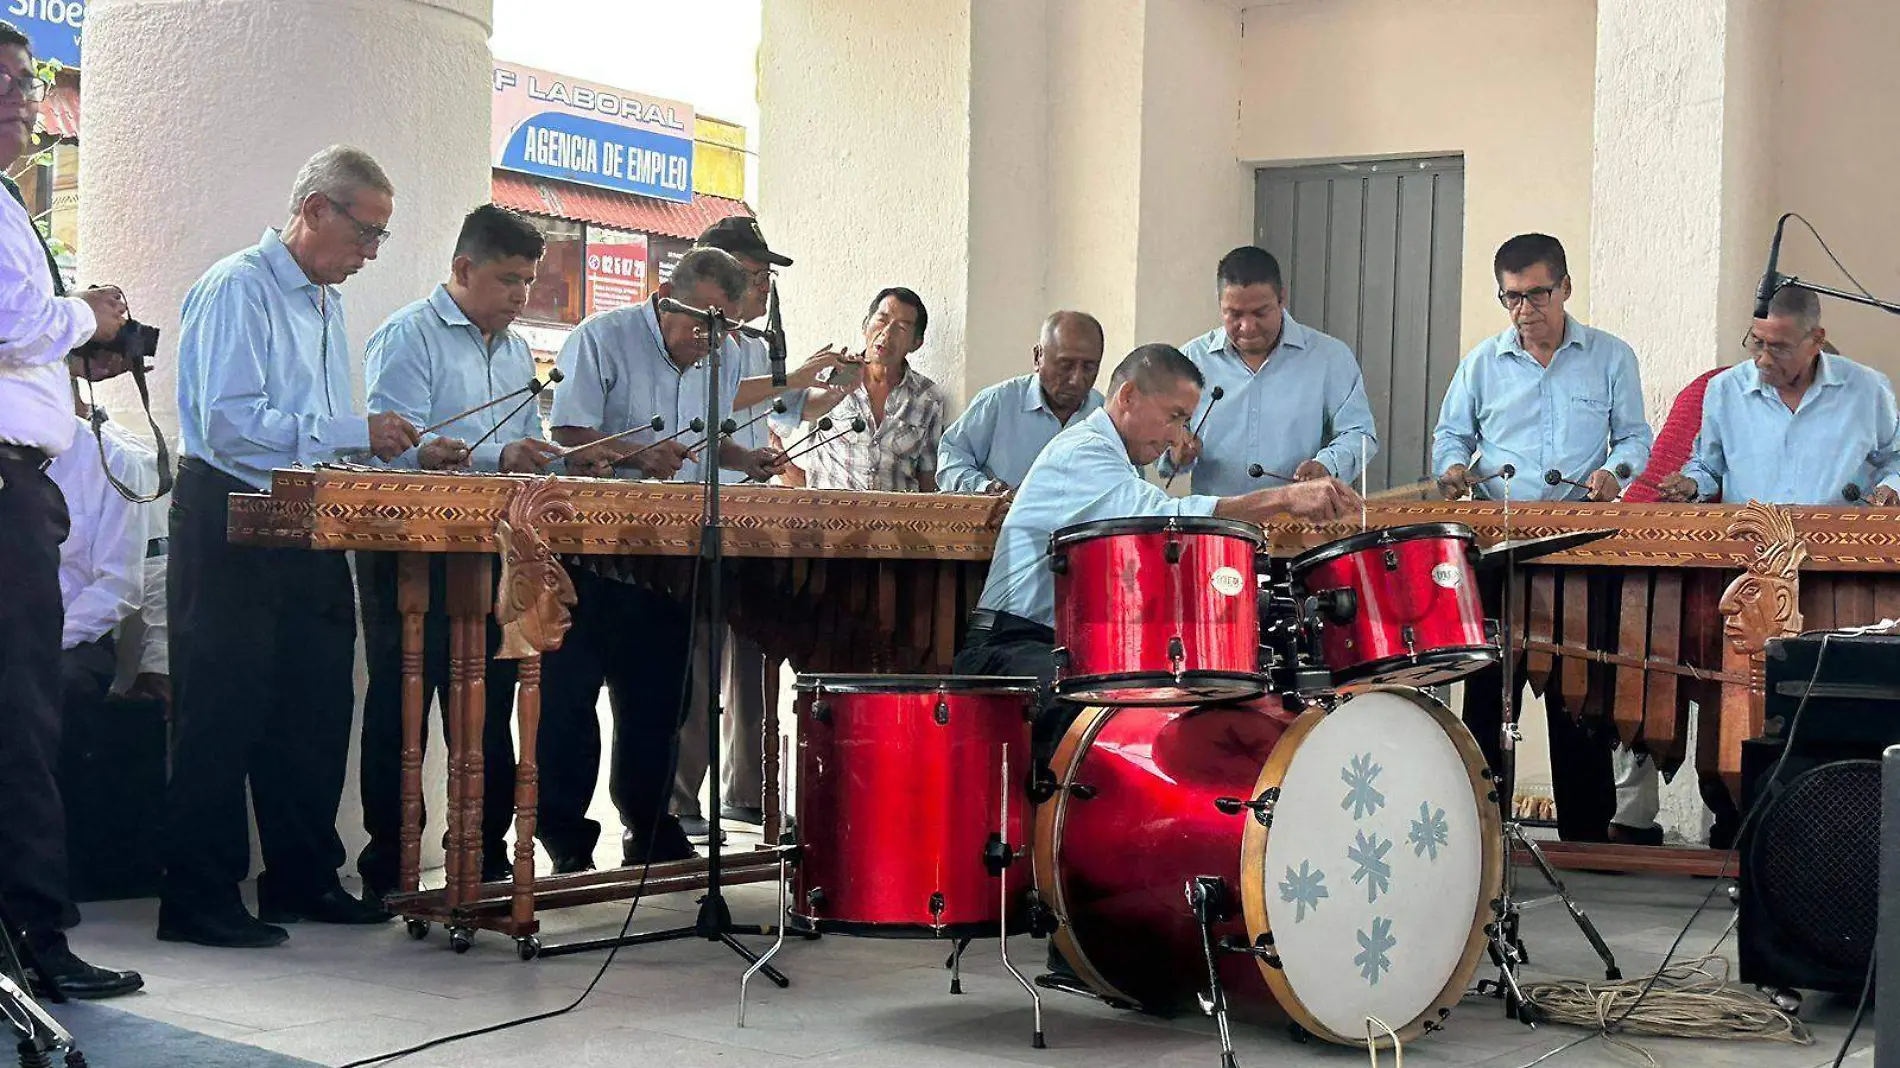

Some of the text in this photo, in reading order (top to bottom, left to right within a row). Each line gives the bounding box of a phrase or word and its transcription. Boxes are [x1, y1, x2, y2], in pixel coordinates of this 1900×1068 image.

[8, 0, 86, 28] Shoe
[528, 76, 685, 131] LABORAL
[524, 126, 688, 192] AGENCIA DE EMPLEO
